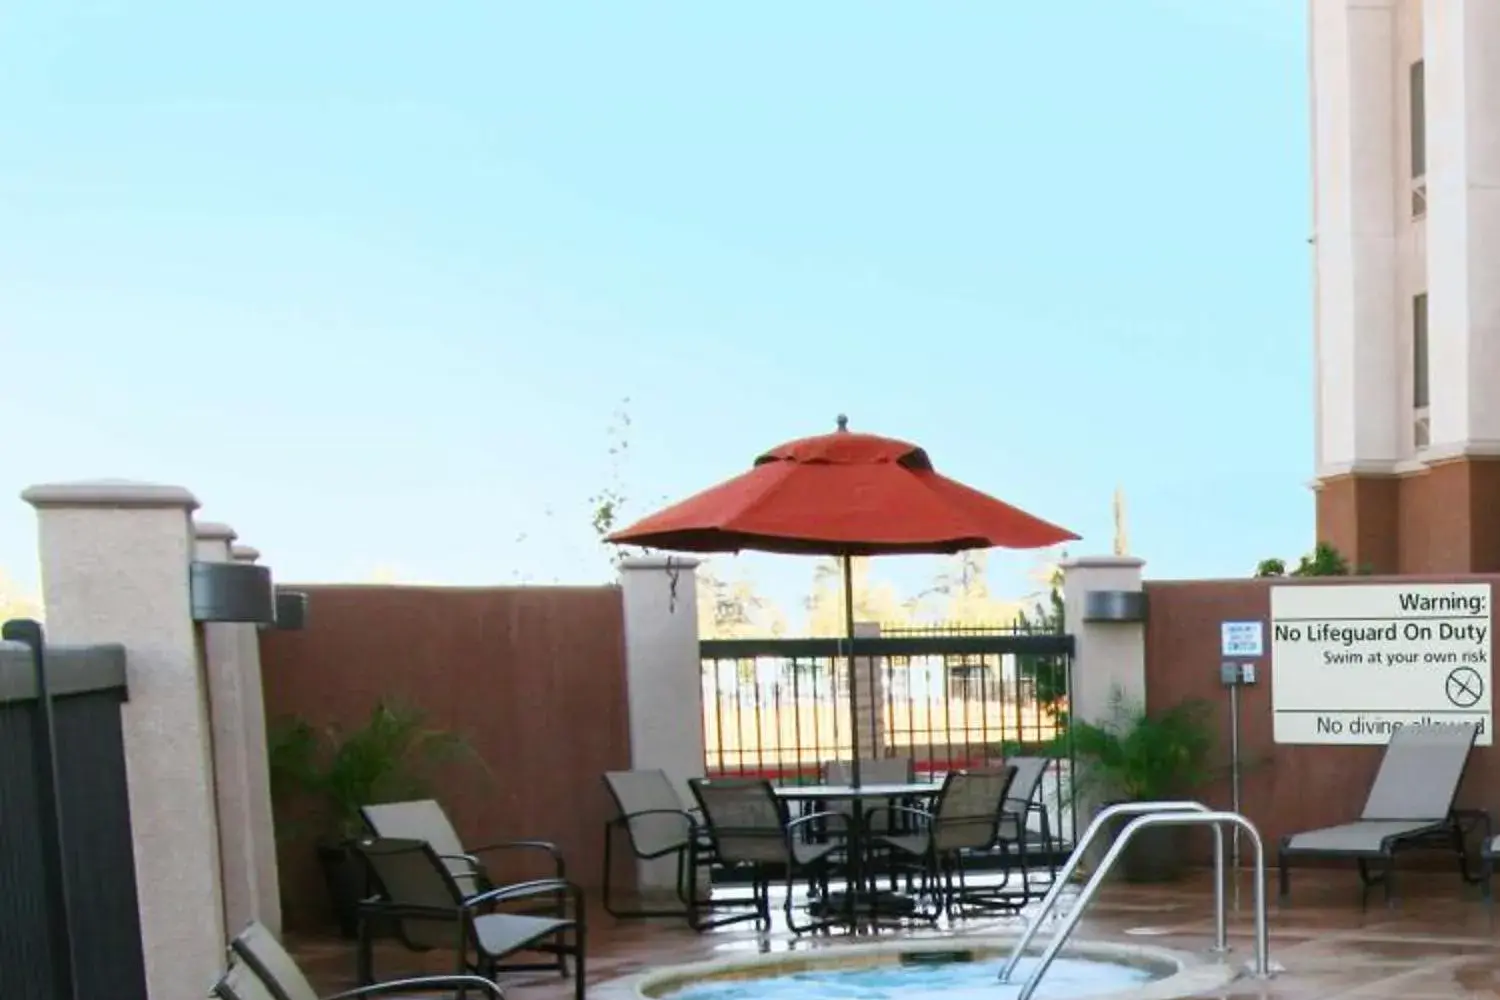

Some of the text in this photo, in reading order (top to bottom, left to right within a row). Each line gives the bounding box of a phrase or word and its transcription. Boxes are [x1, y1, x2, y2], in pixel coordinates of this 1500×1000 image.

[1399, 592, 1487, 613] Warning:
[1275, 624, 1301, 642] No
[1307, 623, 1397, 647] Lifeguard
[1403, 623, 1432, 641] On
[1439, 623, 1487, 645] Duty
[1323, 650, 1487, 667] Swim at your own risk
[1317, 716, 1343, 735] No
